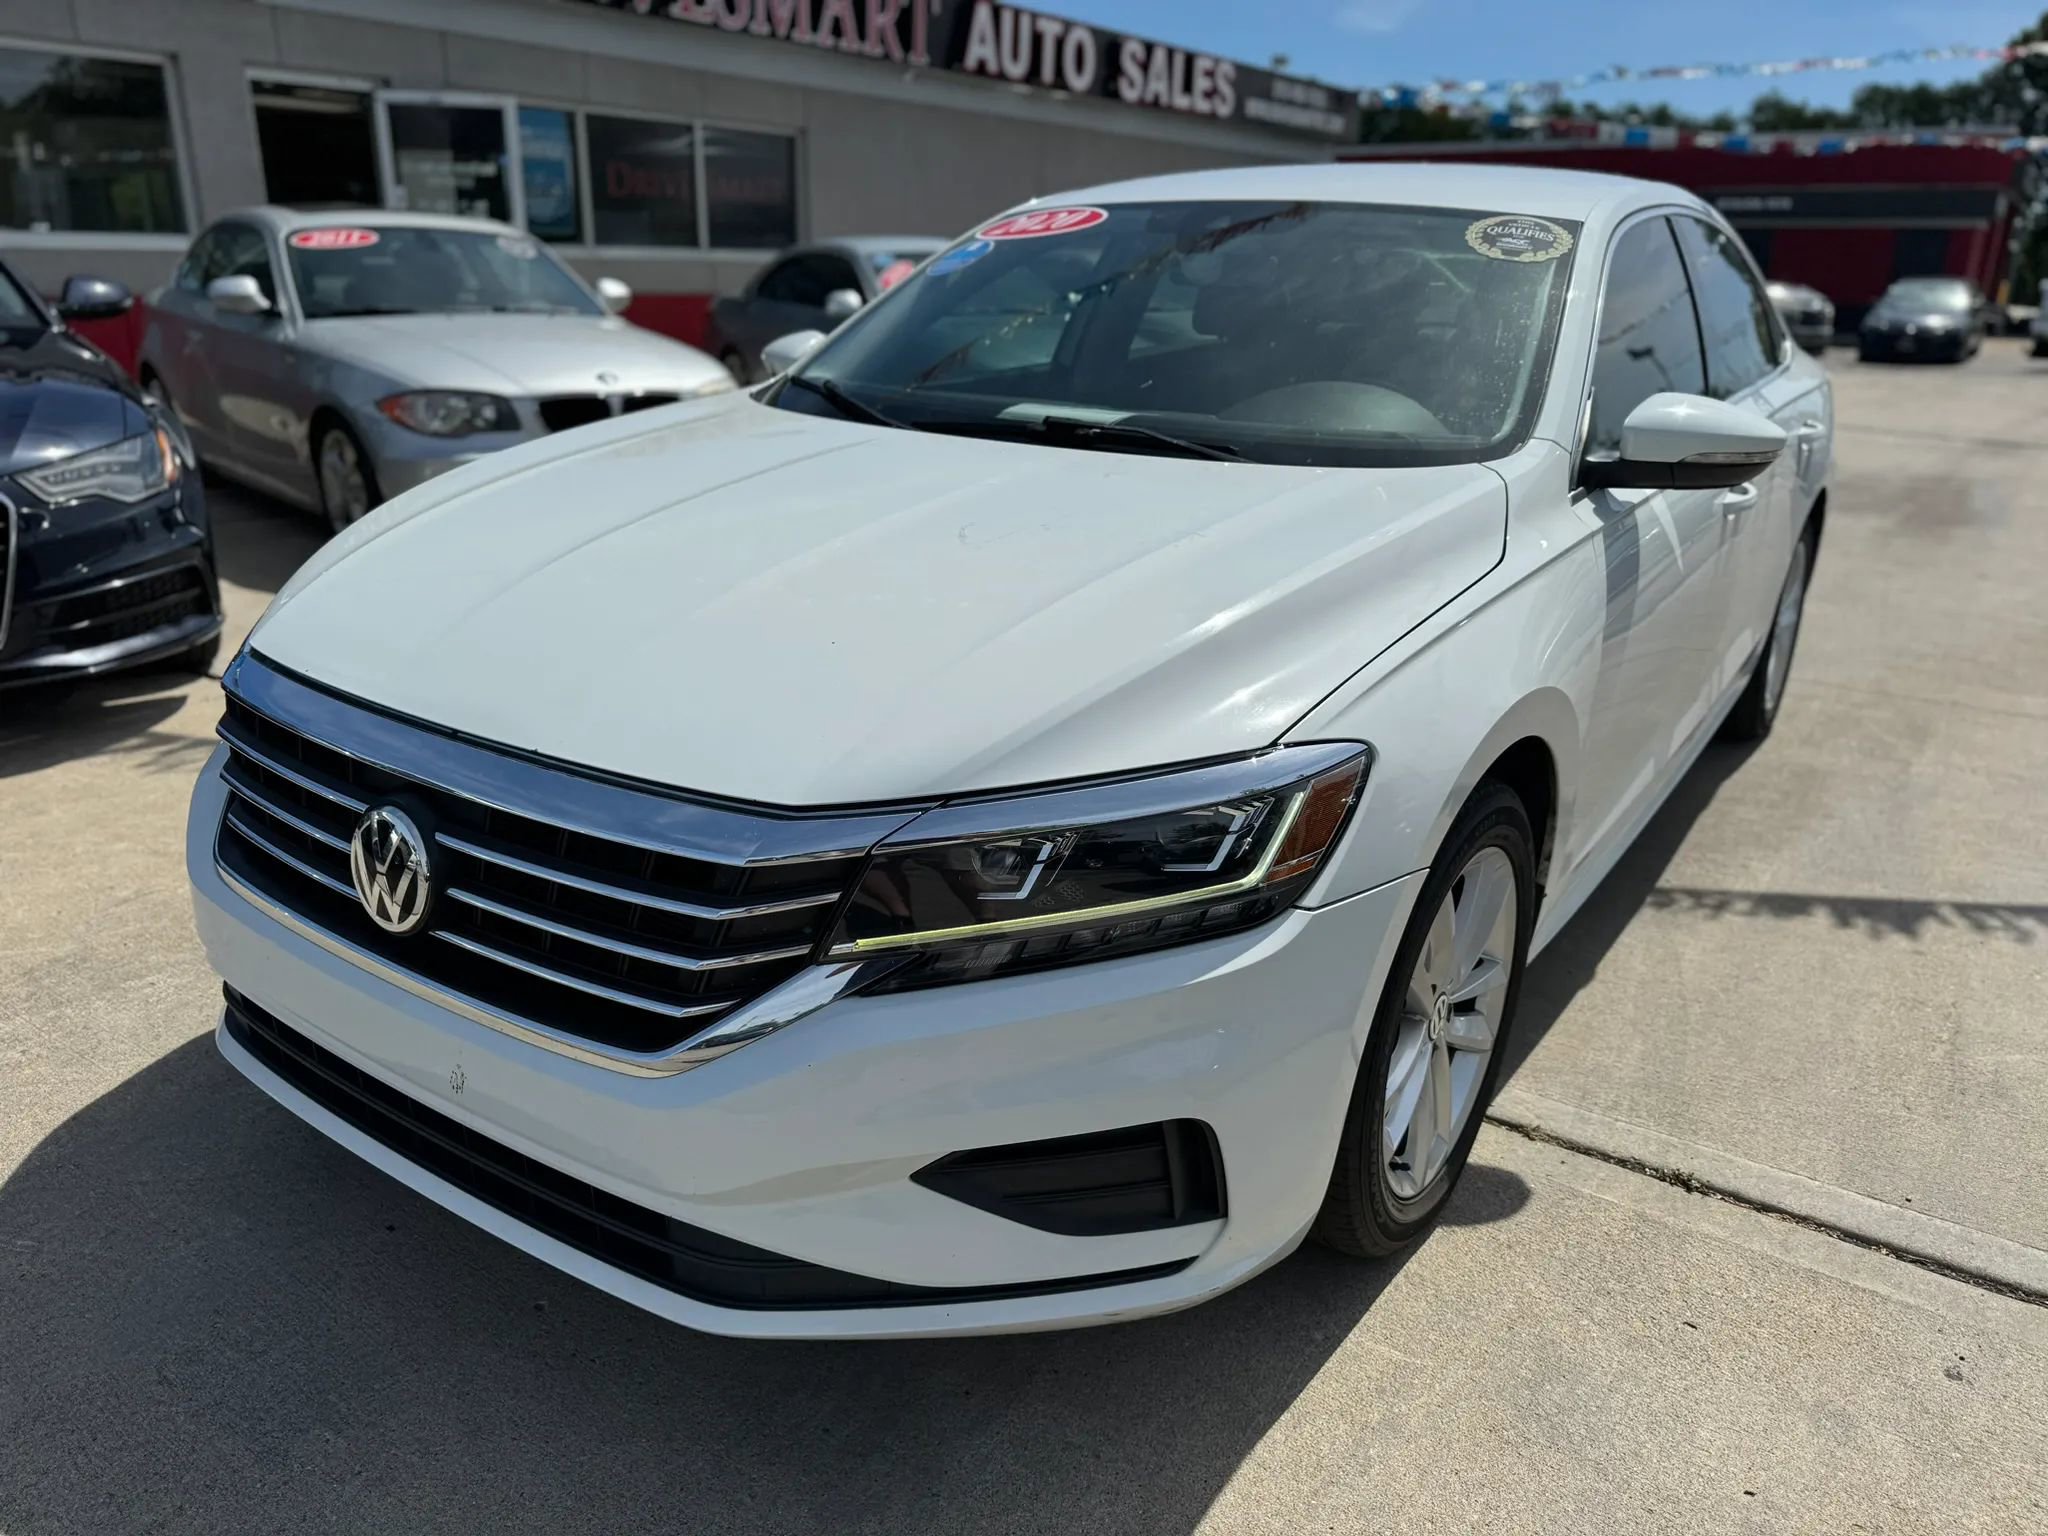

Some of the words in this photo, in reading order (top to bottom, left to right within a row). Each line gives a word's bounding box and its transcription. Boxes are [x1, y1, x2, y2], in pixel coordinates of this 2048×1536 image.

[962, 1, 1097, 94] AUTO
[1117, 36, 1237, 118] SALES
[985, 209, 1092, 236] 2020
[1486, 224, 1556, 242] QUALIFIES
